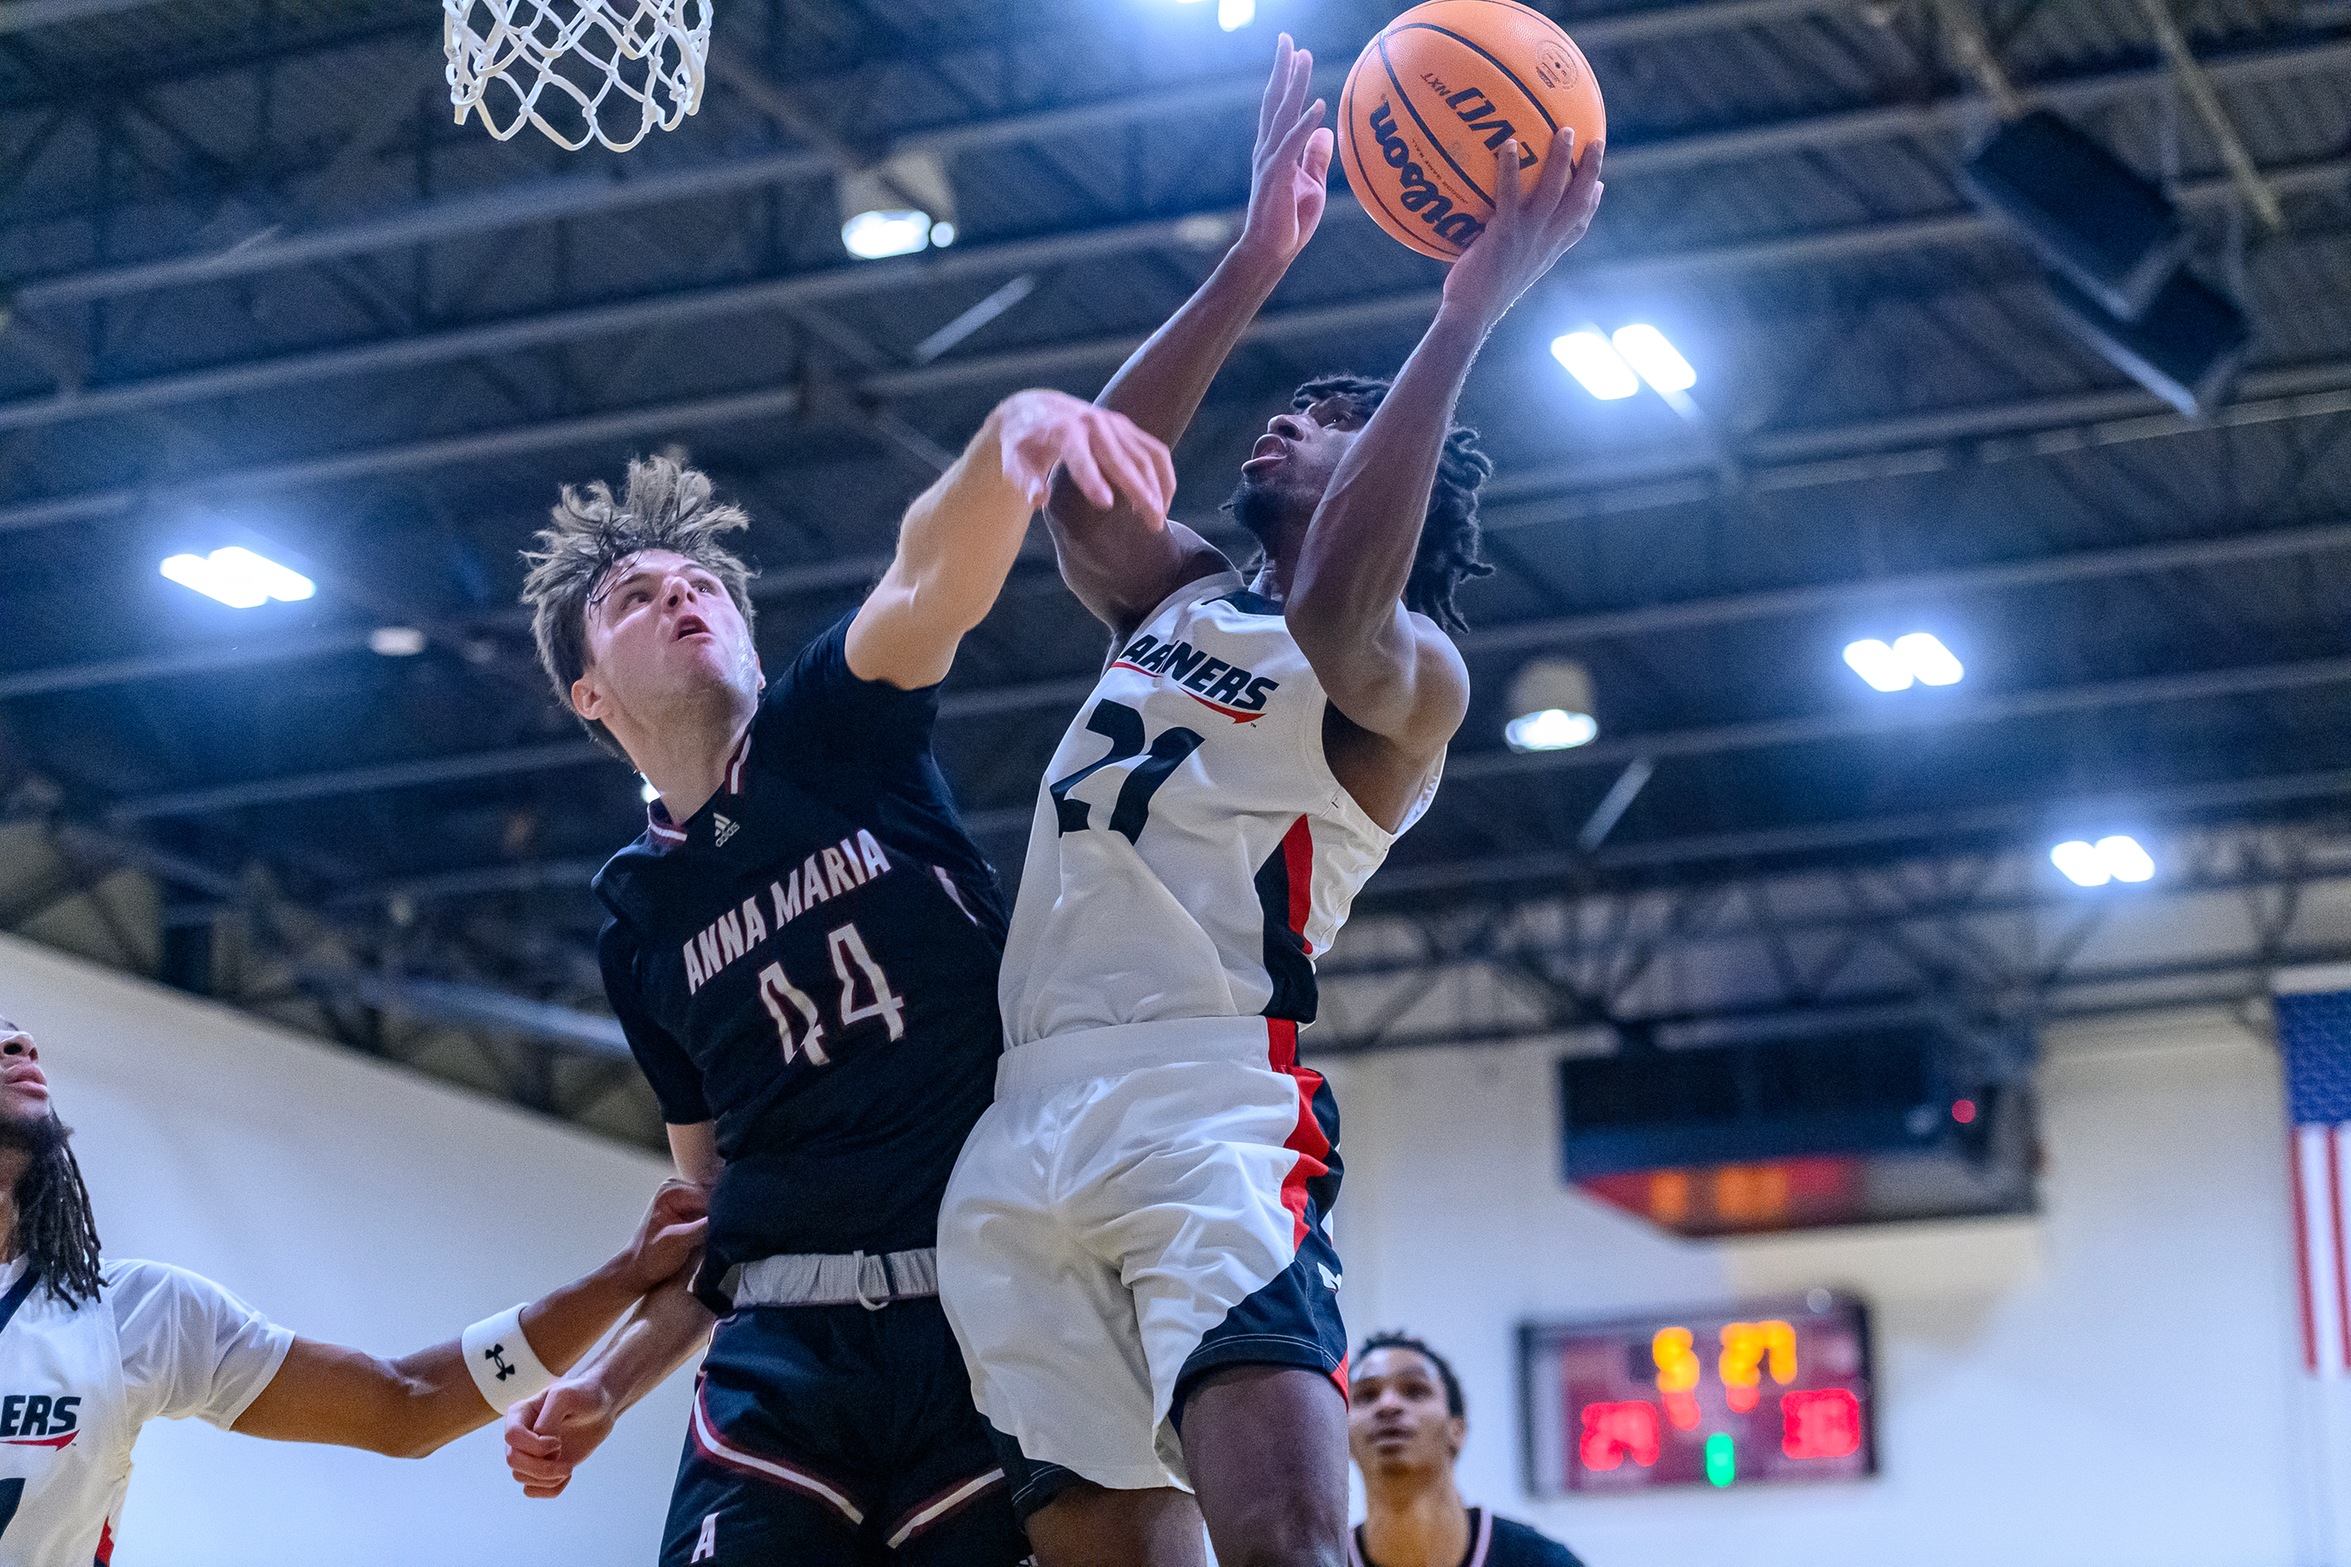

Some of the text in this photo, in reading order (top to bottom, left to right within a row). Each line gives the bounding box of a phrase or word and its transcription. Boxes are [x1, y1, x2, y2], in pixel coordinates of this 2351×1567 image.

[1420, 72, 1451, 96] NXT
[1370, 101, 1487, 250] Wilson
[1424, 160, 1442, 180] GAME
[1442, 180, 1469, 204] INDOOR
[1050, 698, 1206, 846] 21
[715, 821, 740, 848] adidas
[682, 828, 891, 996] ANNA MARIA
[758, 922, 905, 1066] 44
[690, 1511, 720, 1565] A
